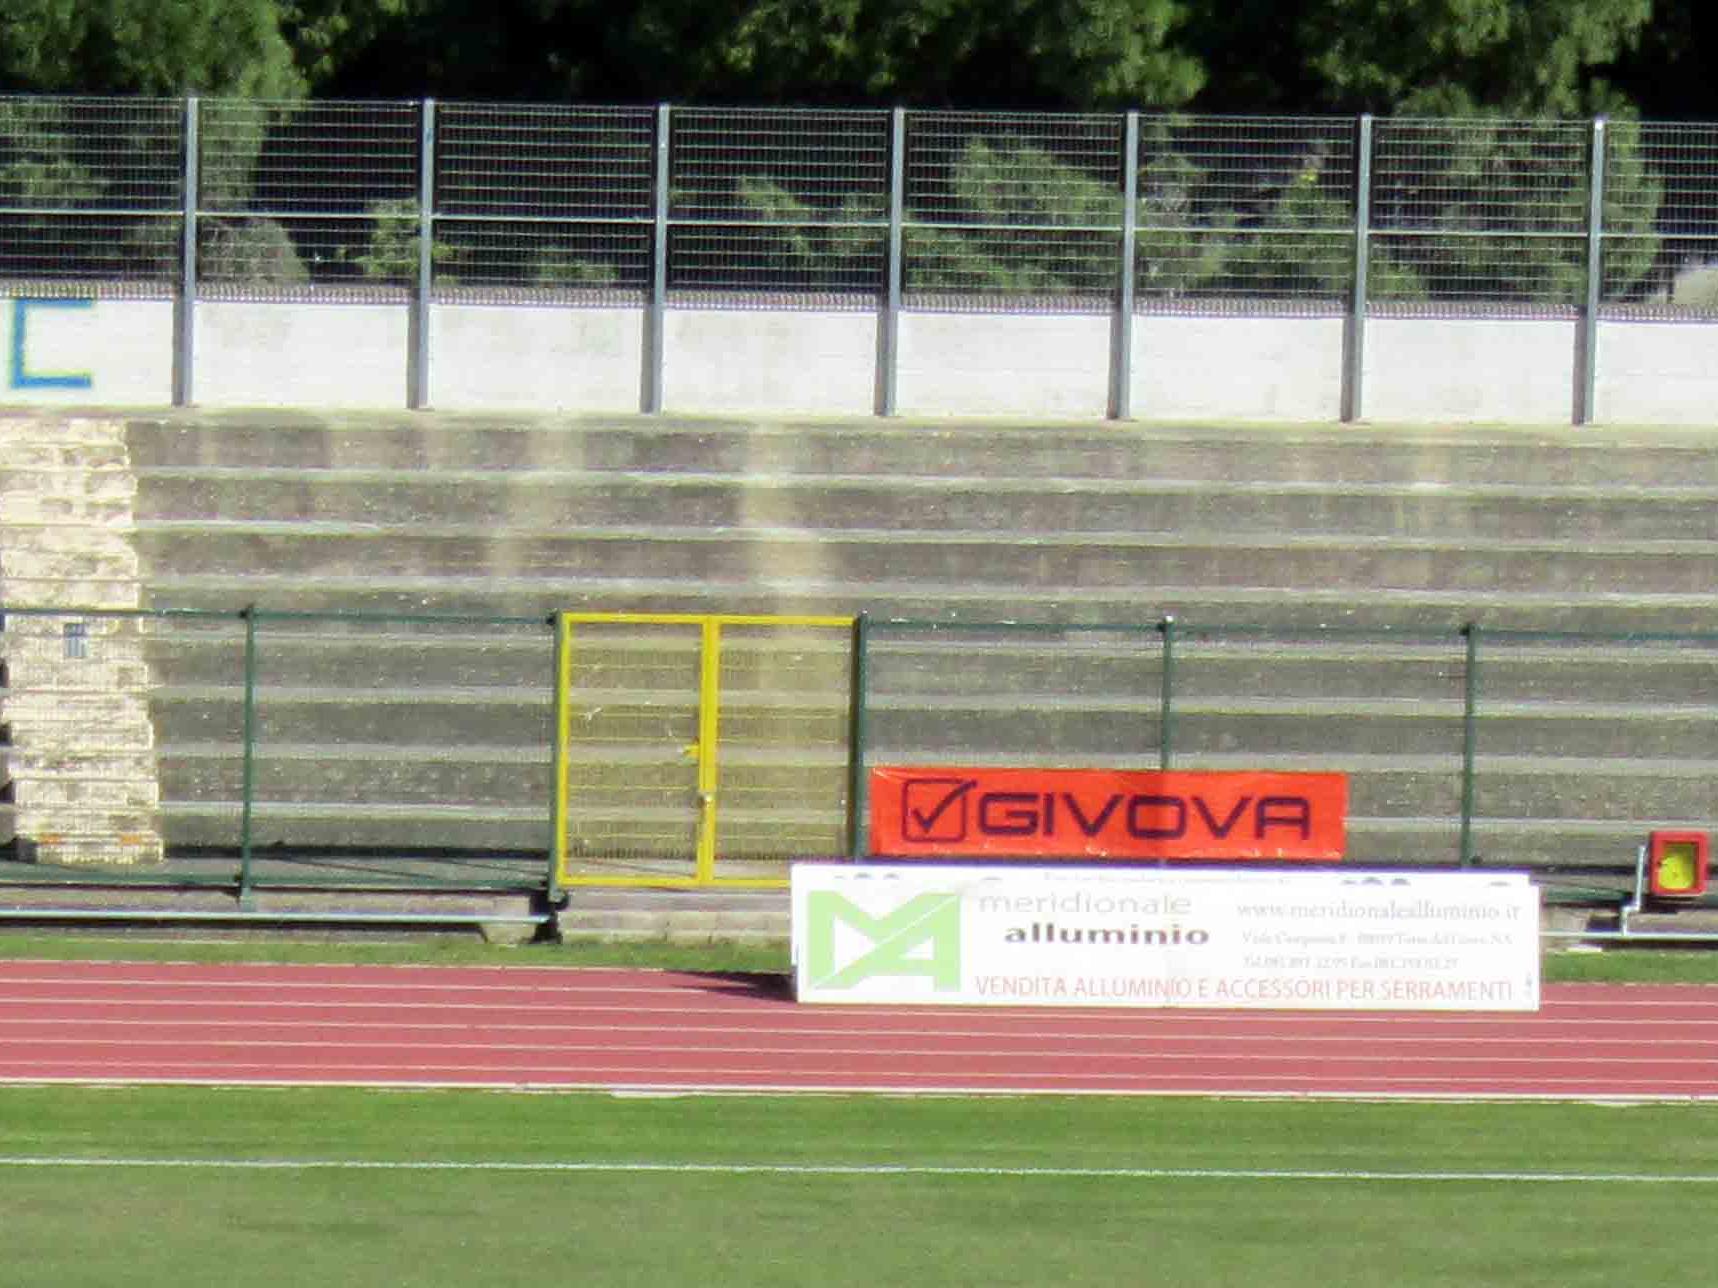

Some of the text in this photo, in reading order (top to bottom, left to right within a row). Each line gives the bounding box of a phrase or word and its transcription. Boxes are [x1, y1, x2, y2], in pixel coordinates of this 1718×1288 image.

[977, 792, 1311, 841] GIVOVA
[979, 891, 1192, 915] meridionale
[1004, 922, 1210, 946] alluminio
[976, 976, 1068, 996] VENDITA
[1074, 977, 1192, 998] ALLUMINIO
[1216, 979, 1330, 999] ACCESSORI
[1337, 979, 1375, 1000] PER
[1380, 980, 1513, 1000] SERRAMENTI
